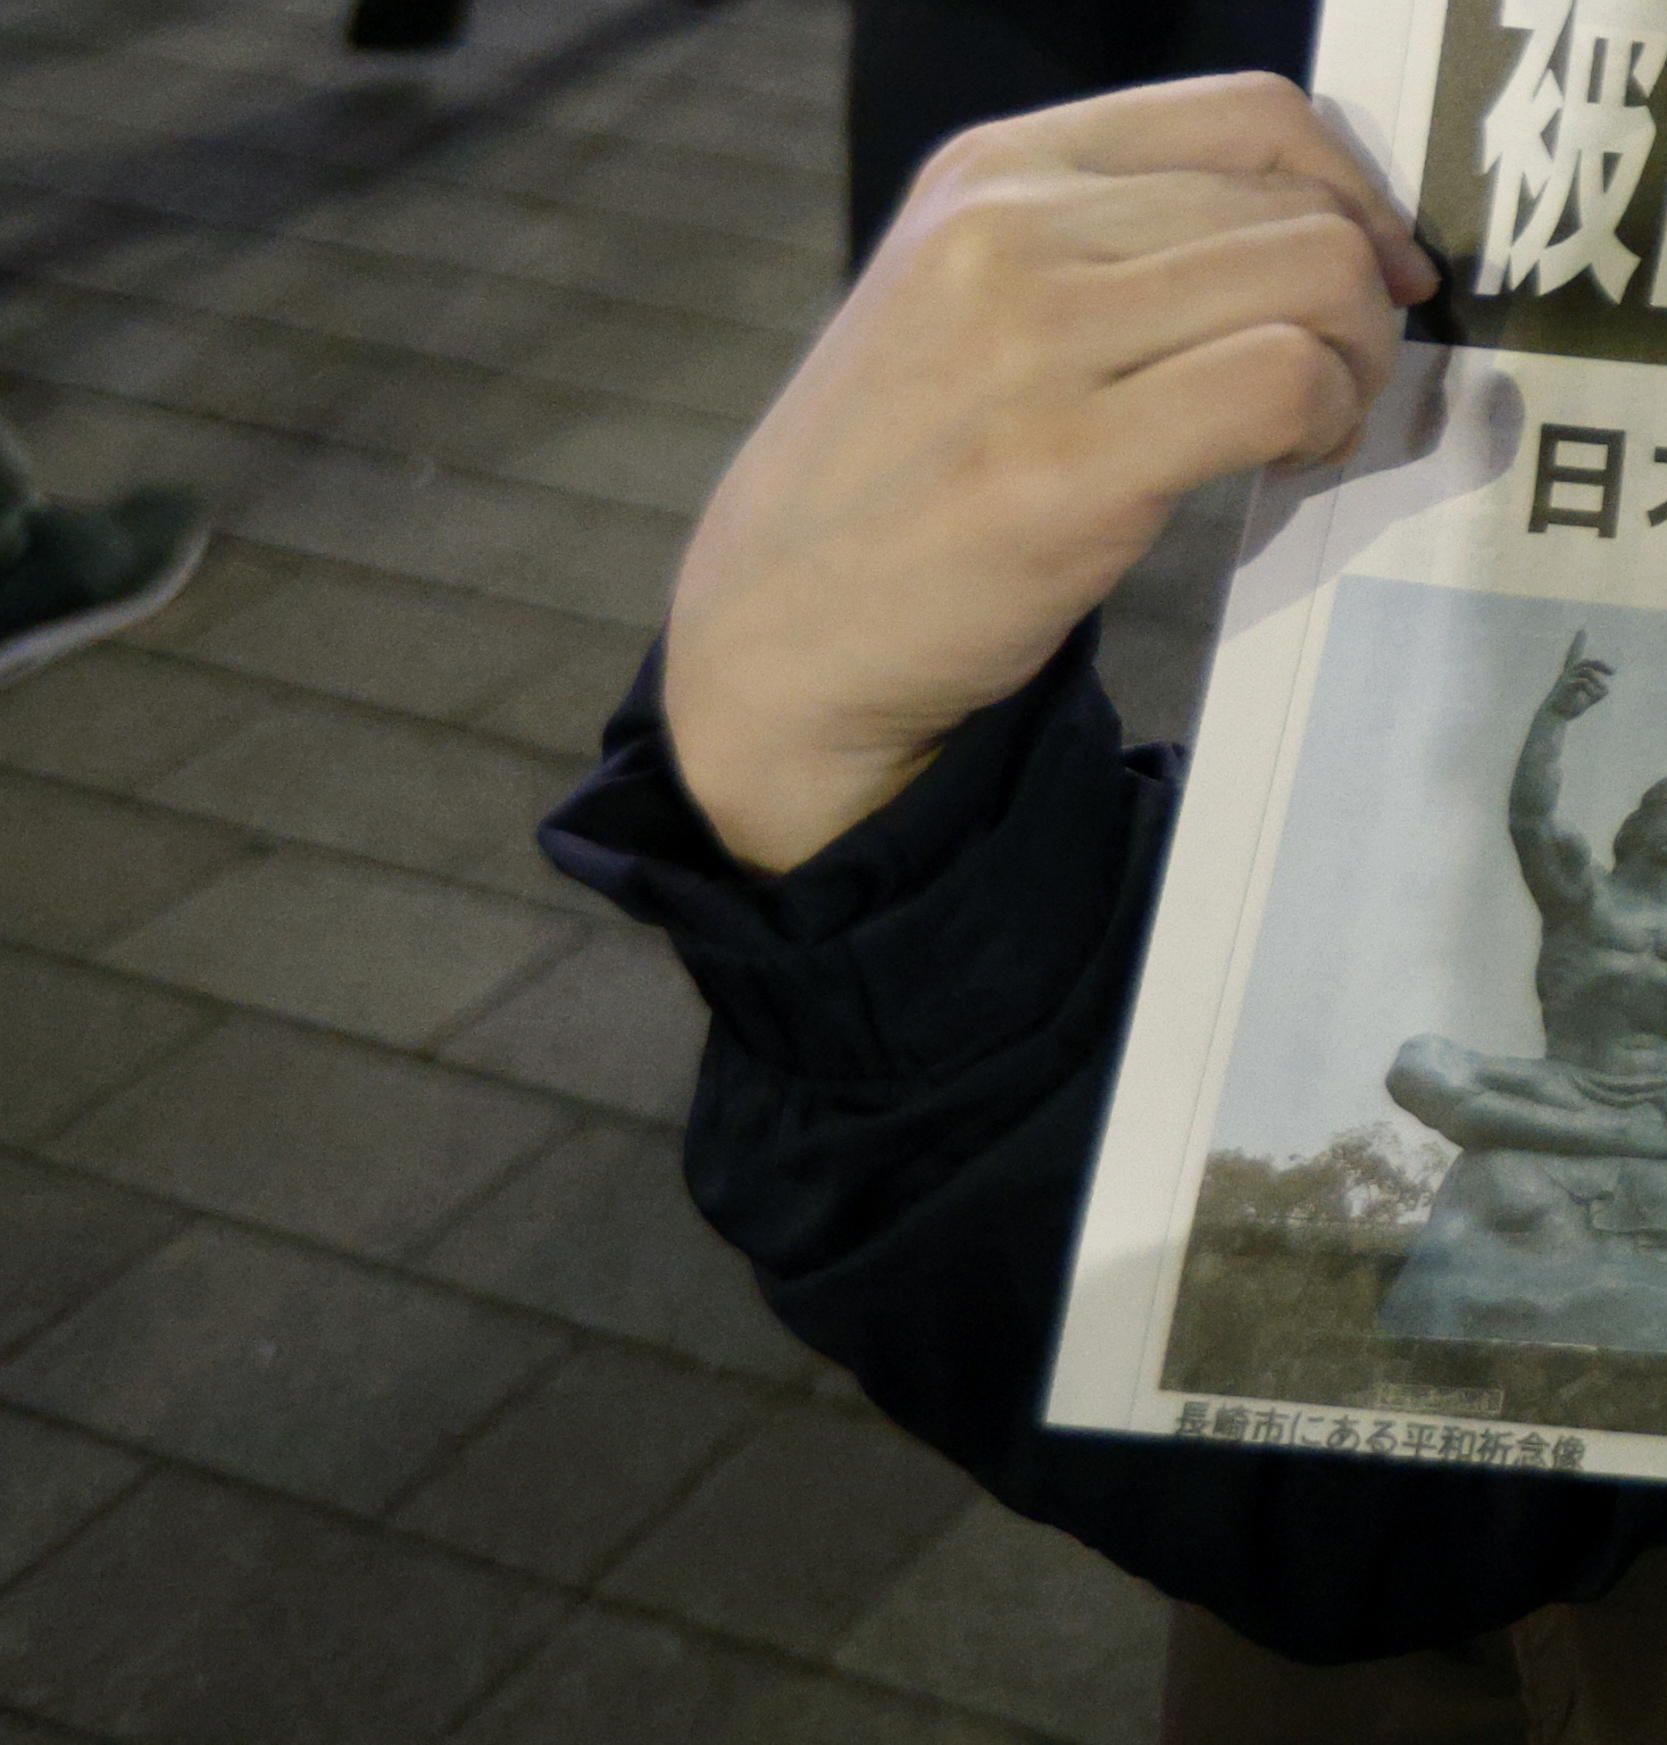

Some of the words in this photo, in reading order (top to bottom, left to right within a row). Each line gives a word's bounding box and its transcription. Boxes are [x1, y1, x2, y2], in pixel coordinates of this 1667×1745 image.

[1175, 1399, 1587, 1471] 長崎市にある平和祈念像
